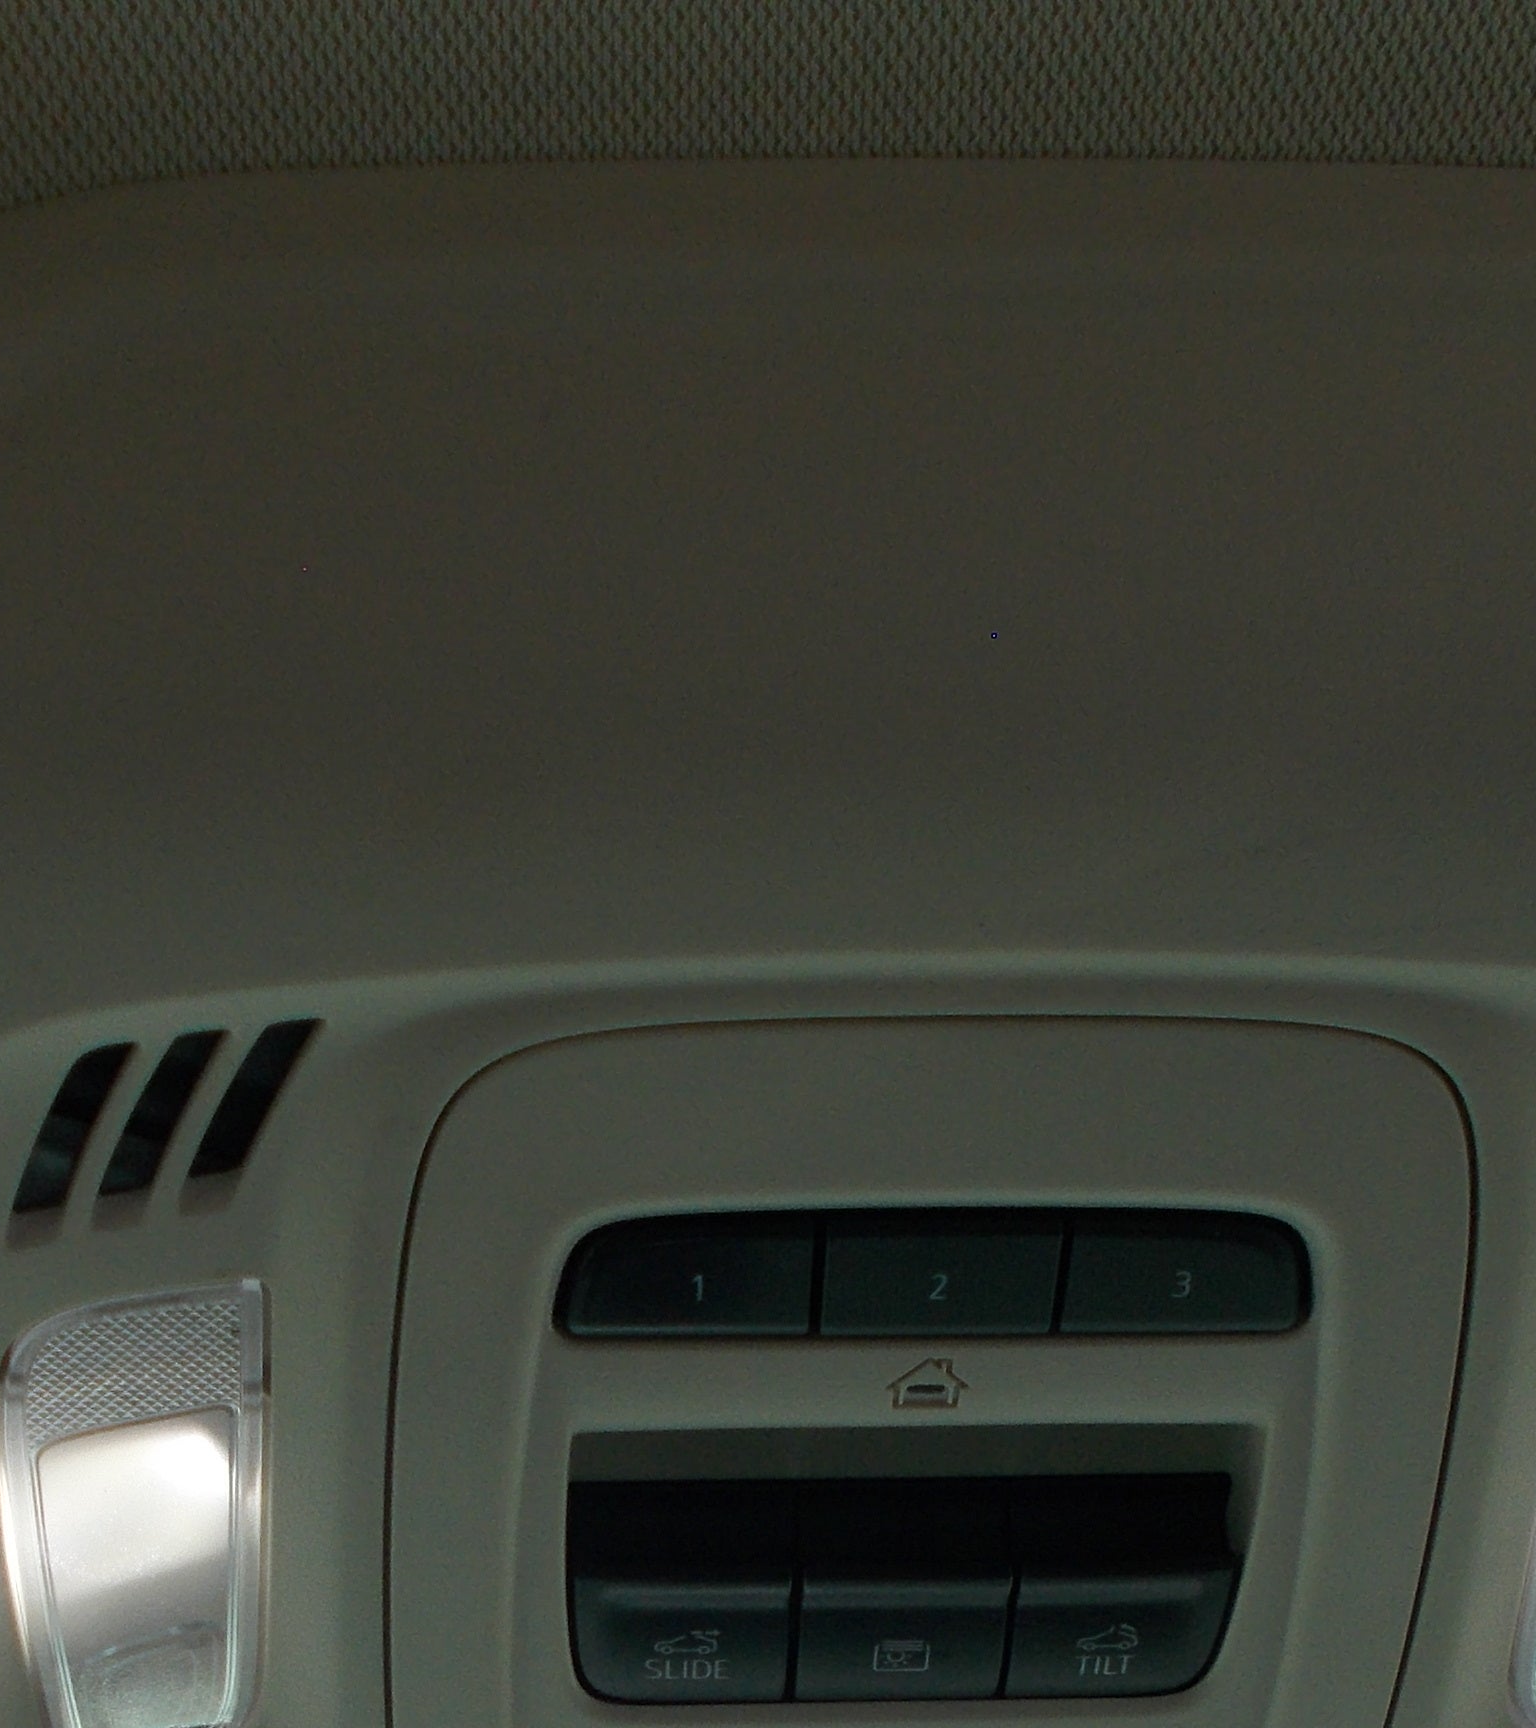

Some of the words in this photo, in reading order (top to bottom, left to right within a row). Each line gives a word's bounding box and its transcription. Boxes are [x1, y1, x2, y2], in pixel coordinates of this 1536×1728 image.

[692, 1274, 704, 1301] 1
[929, 1273, 949, 1300] 2
[1172, 1270, 1192, 1298] 3
[645, 1658, 730, 1680] SLIDE
[1076, 1653, 1136, 1676] TILT
